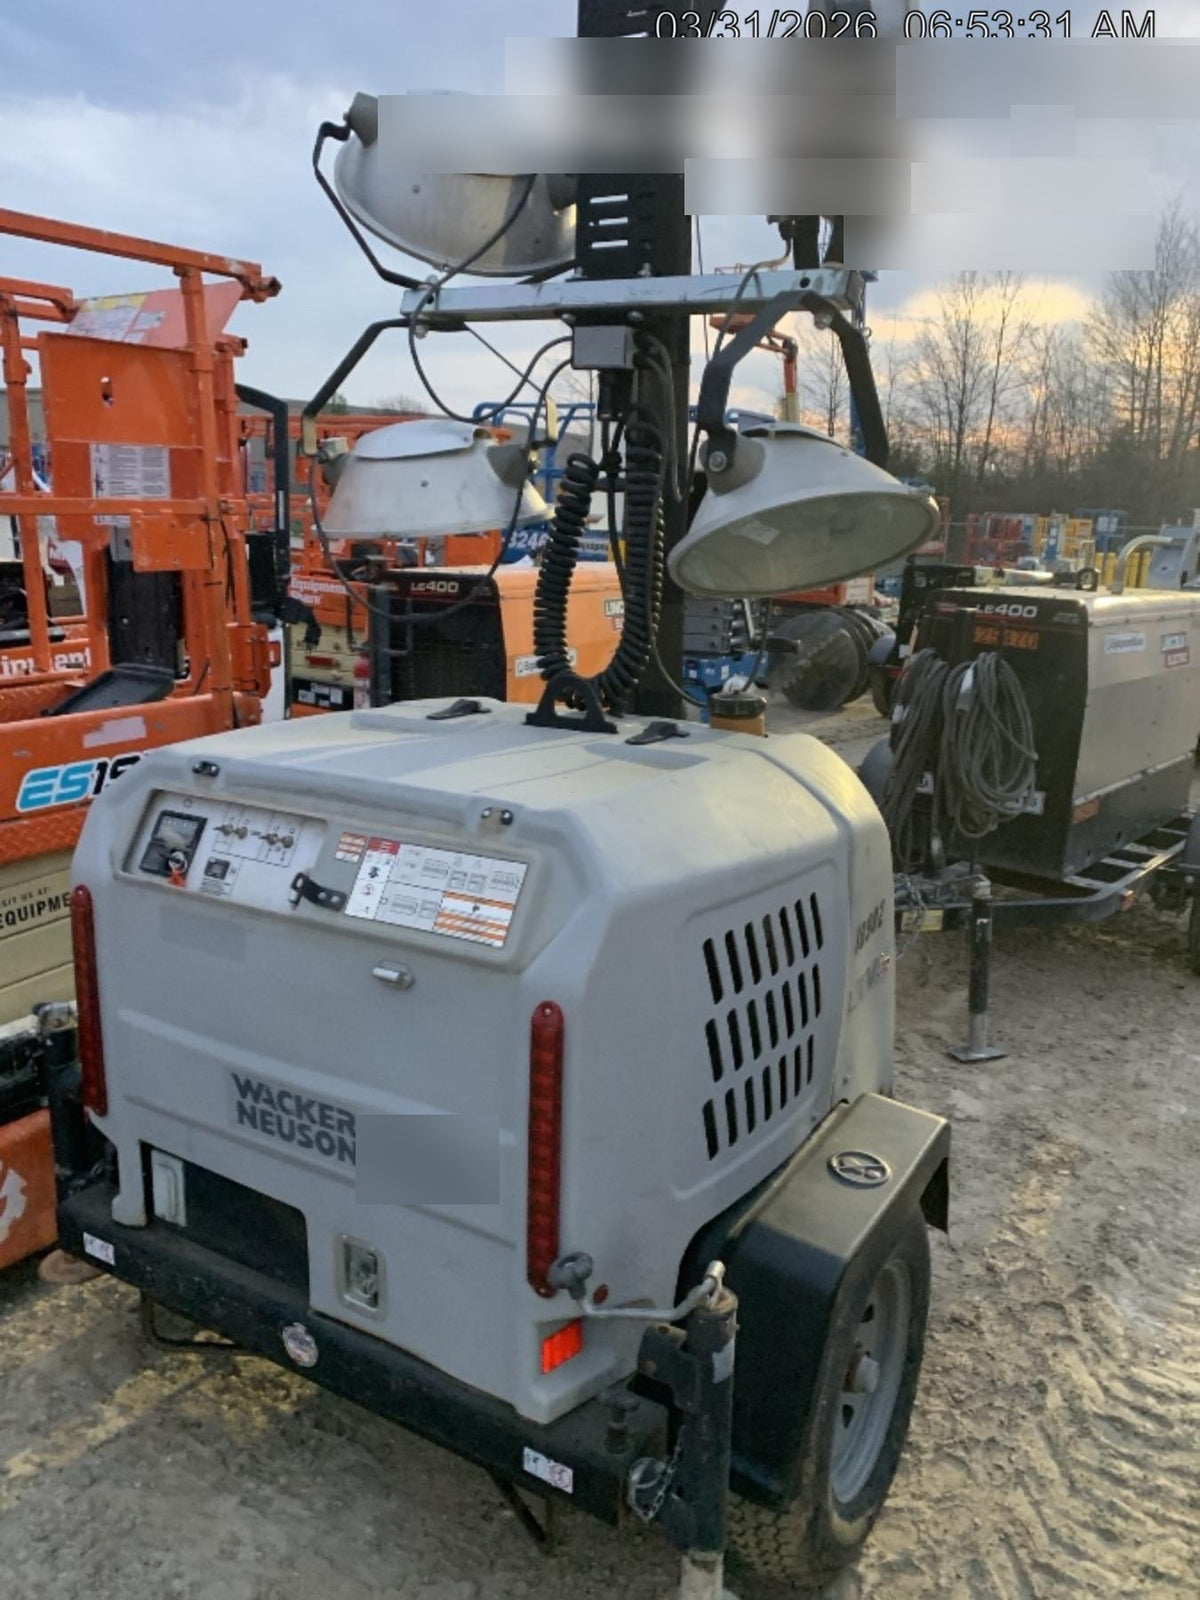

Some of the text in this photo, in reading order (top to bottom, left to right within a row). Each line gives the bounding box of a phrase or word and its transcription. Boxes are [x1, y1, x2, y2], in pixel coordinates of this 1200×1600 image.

[290, 577, 348, 593] Equipmen
[231, 1072, 356, 1138] WACKER
[236, 1100, 356, 1167] NEUSON
